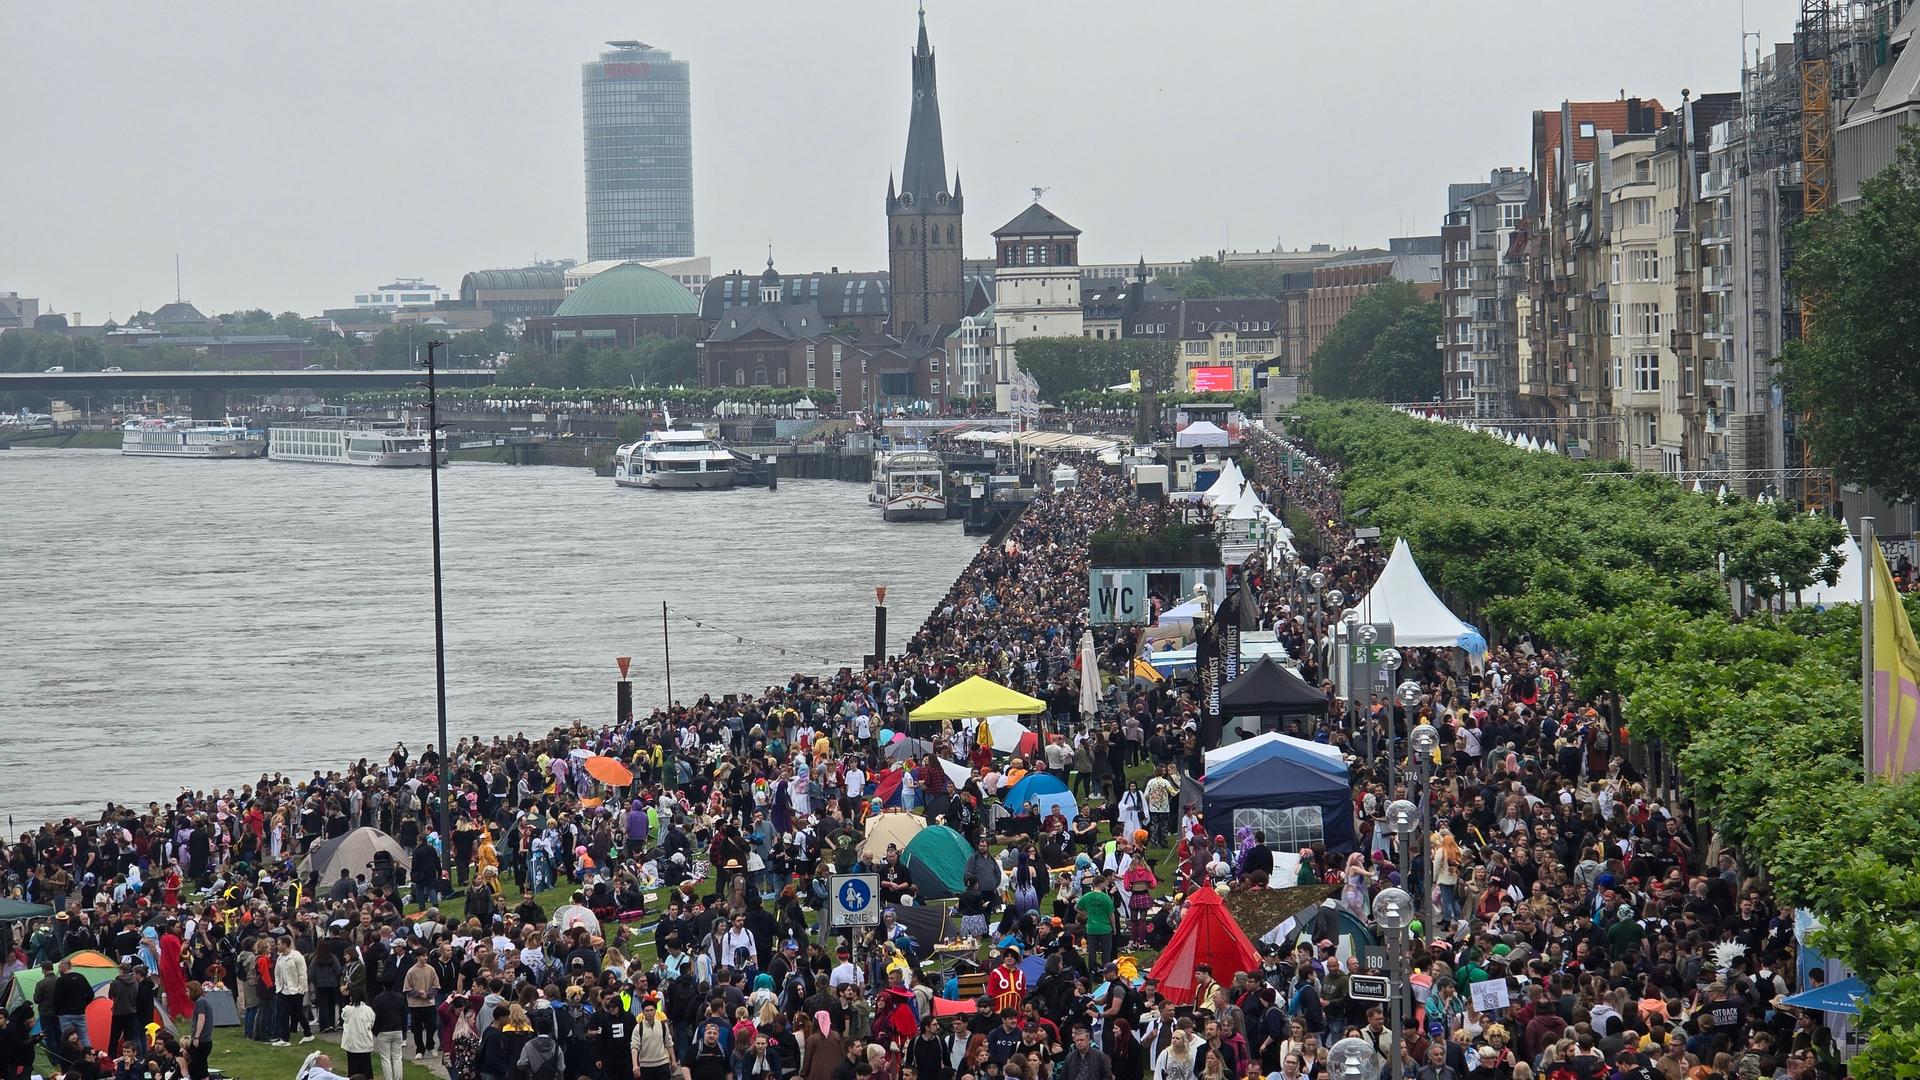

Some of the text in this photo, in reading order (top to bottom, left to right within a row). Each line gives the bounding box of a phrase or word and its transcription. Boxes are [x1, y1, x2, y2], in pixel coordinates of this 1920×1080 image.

[1098, 587, 1134, 614] WC
[1226, 624, 1237, 682] CURRYWURST
[1208, 656, 1220, 716] CURRYWURST
[1374, 684, 1385, 692] 172
[1405, 772, 1418, 781] 176
[843, 913, 868, 923] ZONE
[1366, 955, 1383, 969] 180
[1722, 1007, 1738, 1017] BACK
